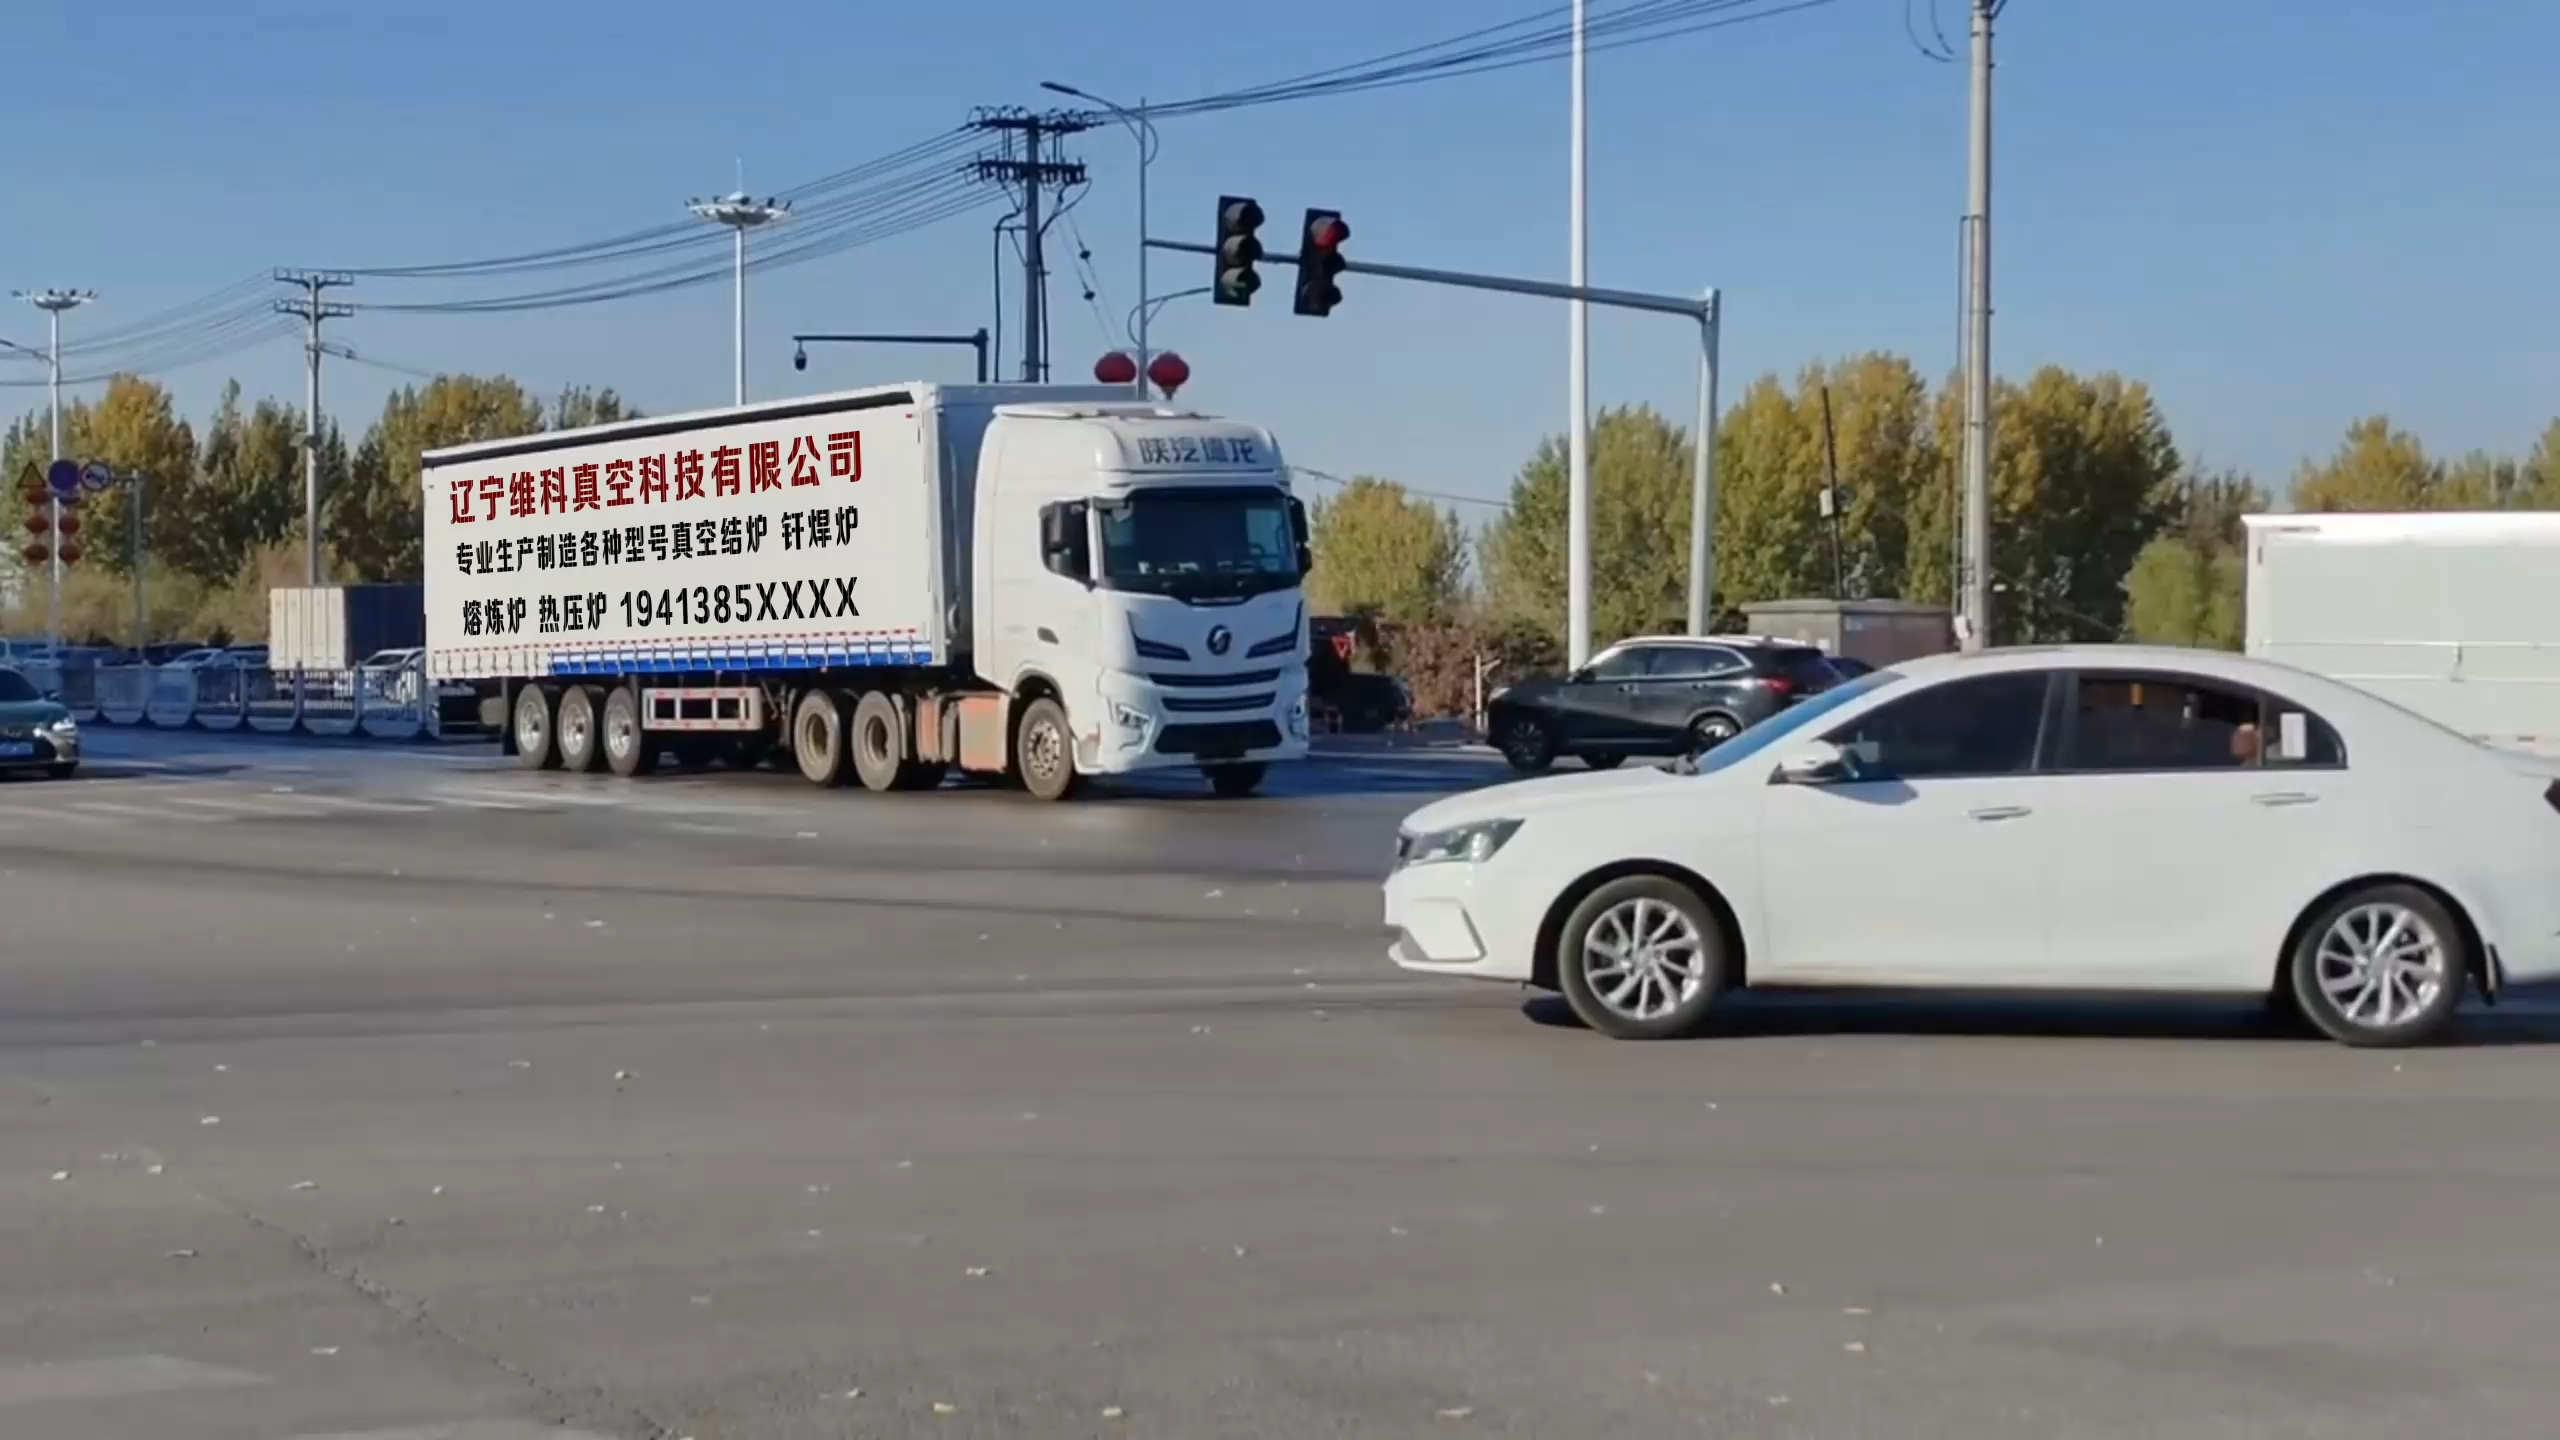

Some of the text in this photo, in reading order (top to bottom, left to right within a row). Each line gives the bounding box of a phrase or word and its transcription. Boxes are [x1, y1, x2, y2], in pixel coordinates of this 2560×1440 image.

[450, 430, 863, 524] 辽宁维科真空科技有限公司
[456, 505, 859, 576] 专业生产制造各种型号真空结炉 钎焊炉
[462, 576, 860, 637] 熔炼炉 热压炉 1941385XXXX
